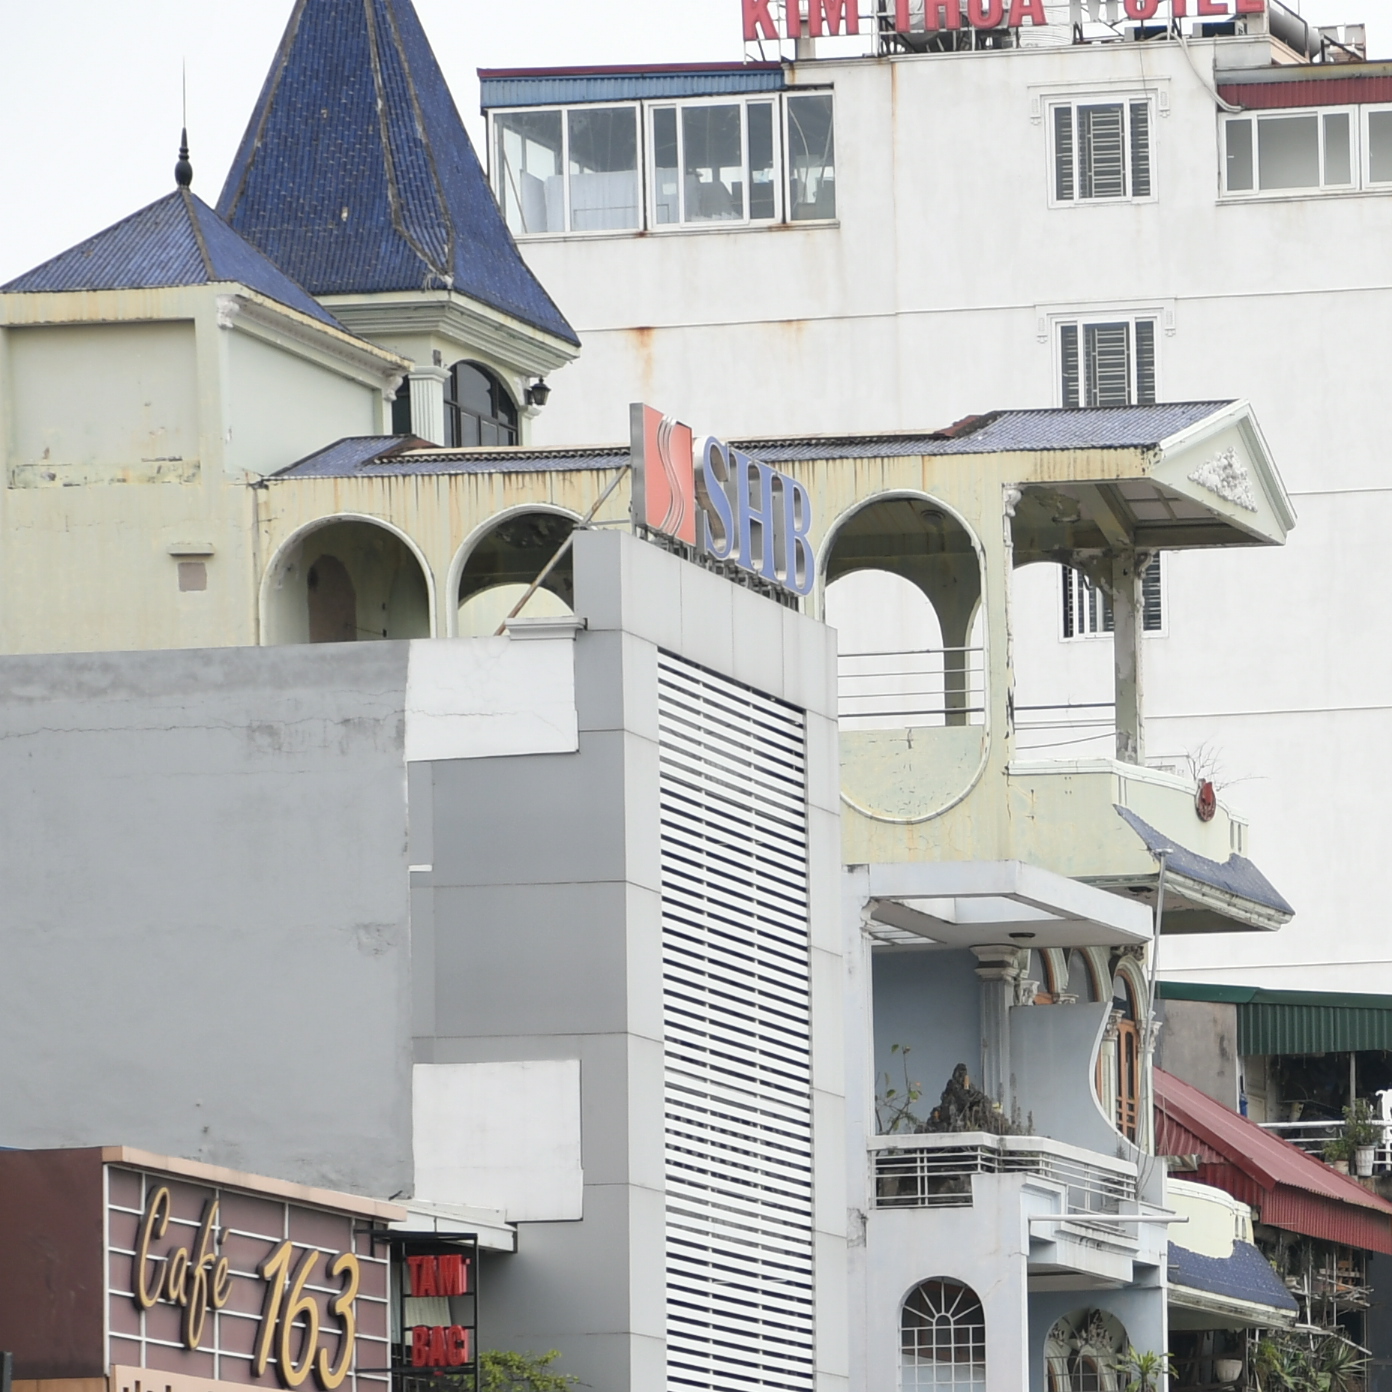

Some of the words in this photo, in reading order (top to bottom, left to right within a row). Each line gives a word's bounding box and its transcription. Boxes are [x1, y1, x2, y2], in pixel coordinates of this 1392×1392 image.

[698, 436, 815, 597] SHB
[134, 1186, 232, 1350] Café
[252, 1240, 360, 1391] 163
